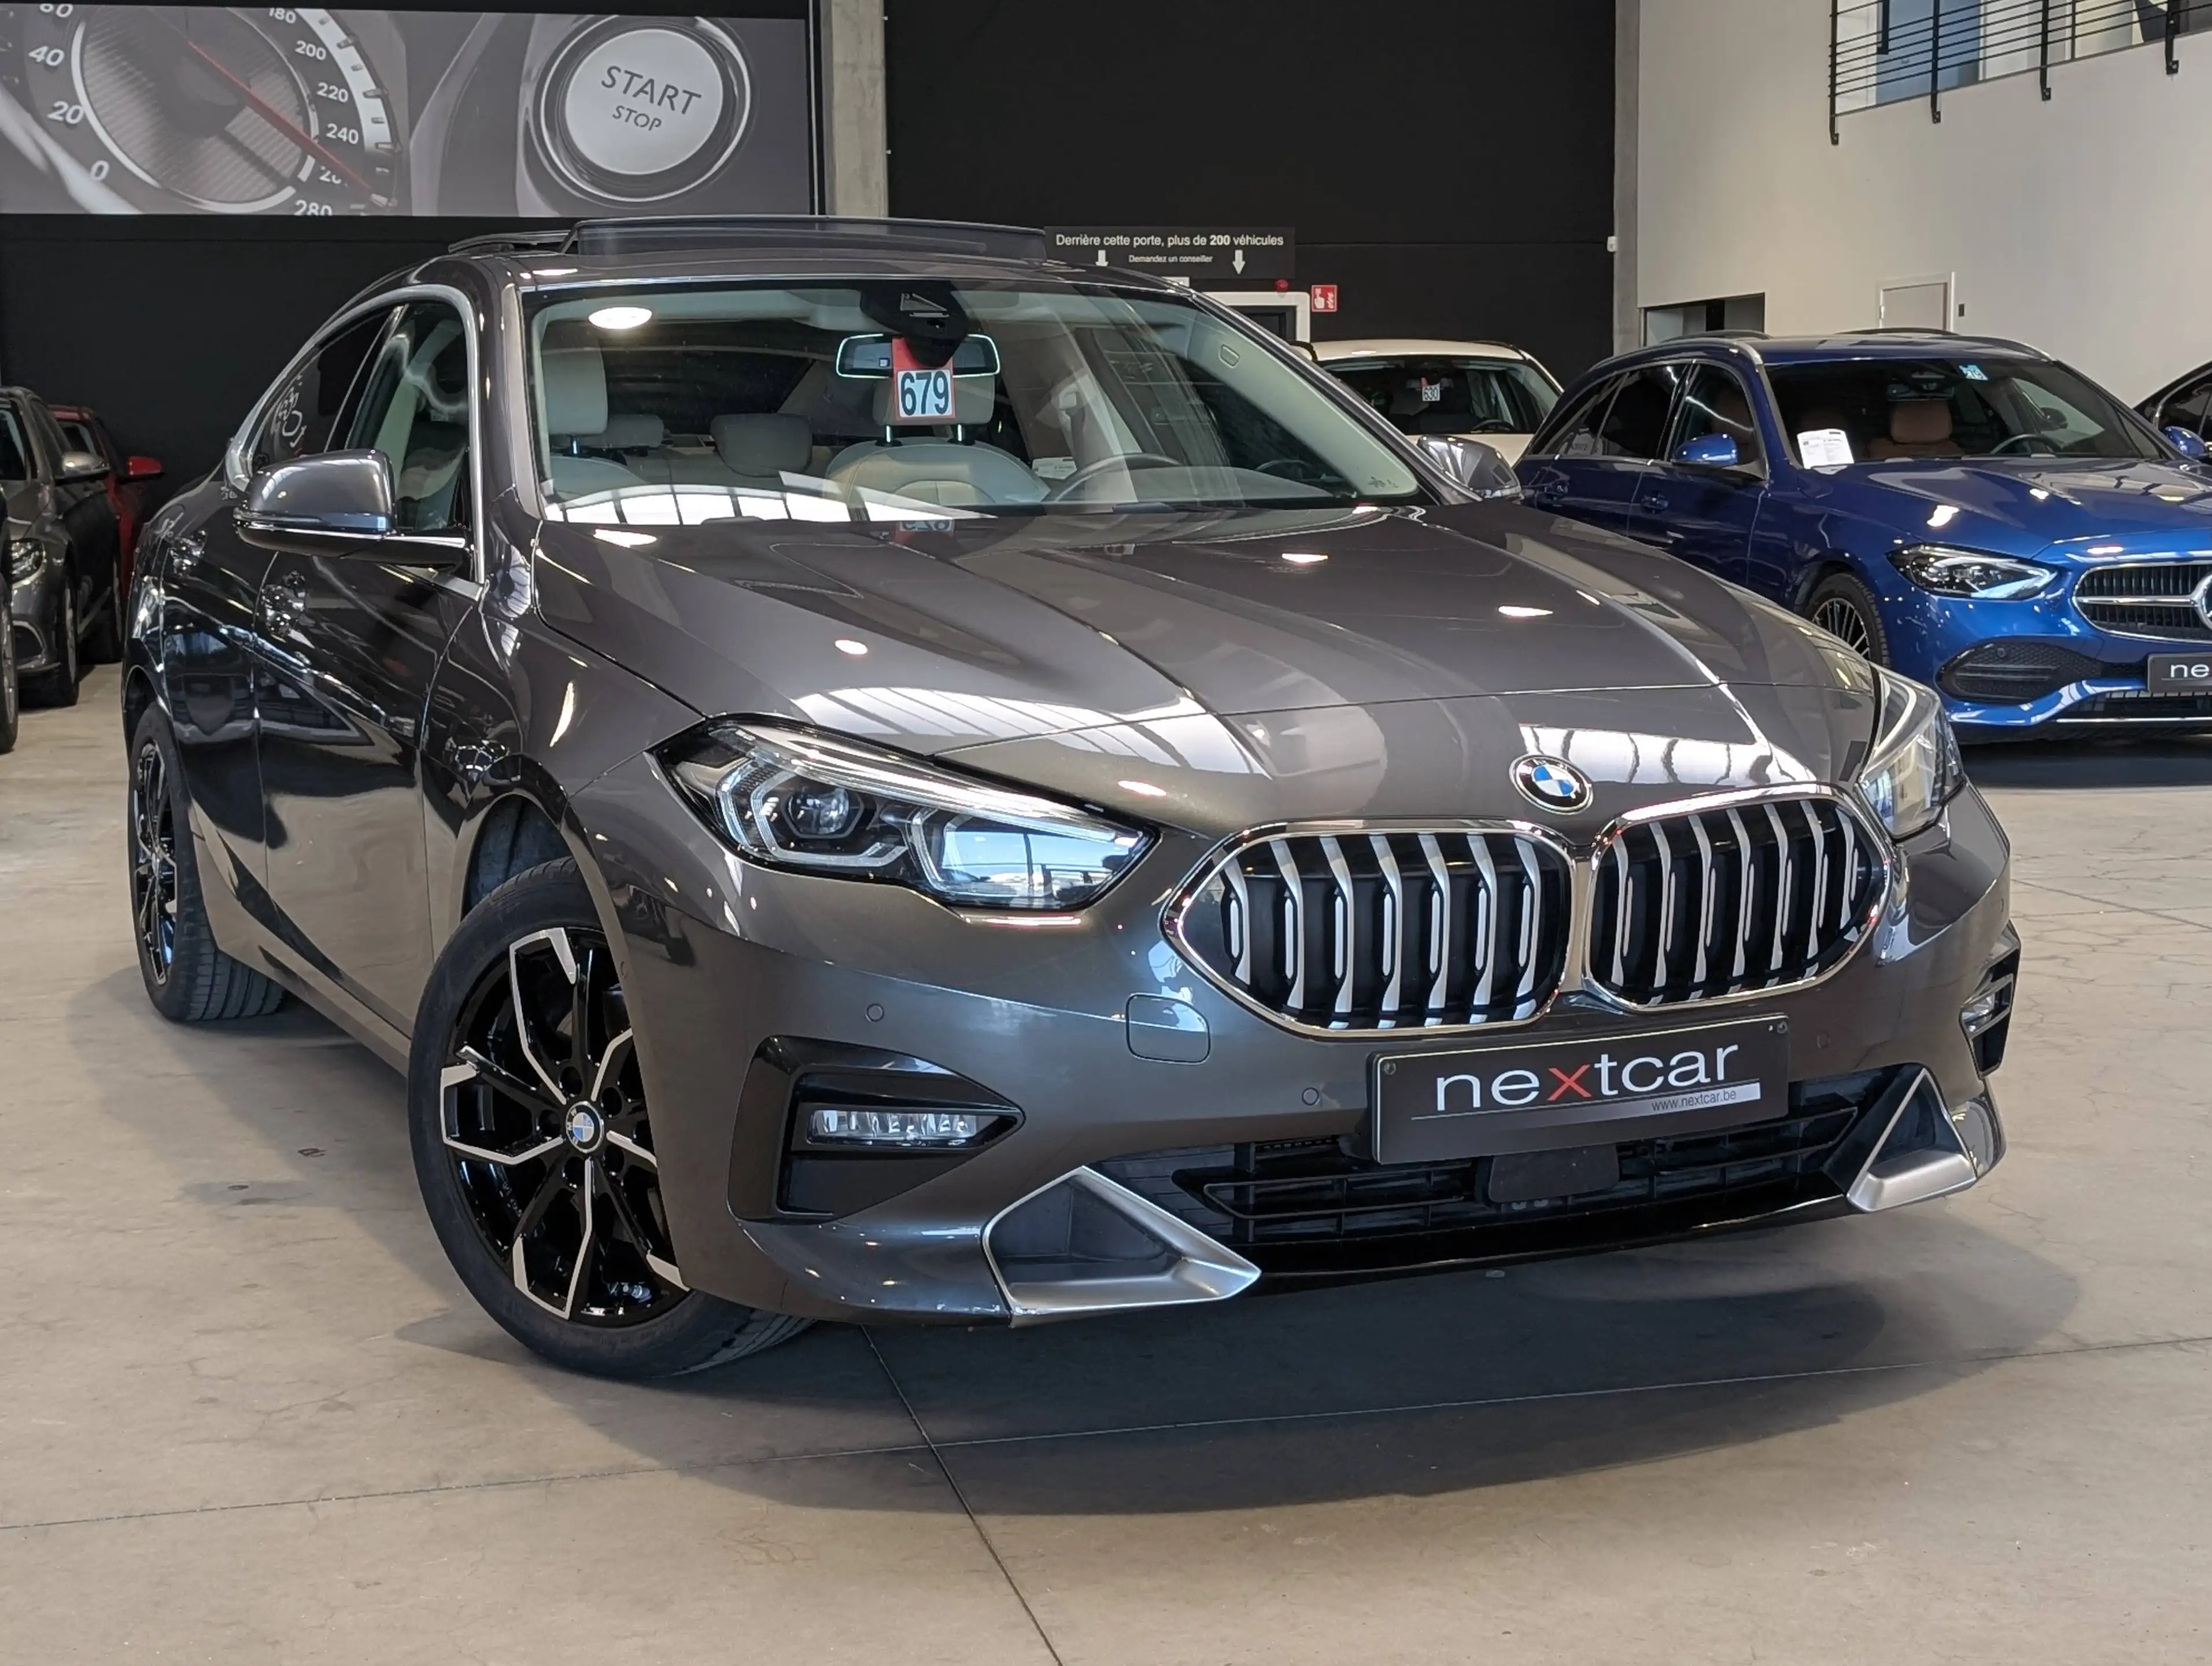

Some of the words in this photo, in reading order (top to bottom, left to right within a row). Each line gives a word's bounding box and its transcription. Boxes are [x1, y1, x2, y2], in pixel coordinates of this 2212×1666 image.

[28, 46, 65, 66] 40
[294, 40, 326, 61] 200
[317, 82, 349, 103] 220
[601, 65, 702, 115] START
[47, 101, 84, 124] 20
[612, 105, 662, 131] STOP
[326, 123, 359, 145] 240
[90, 160, 110, 182] 0
[294, 199, 333, 216] 280
[1055, 234, 1101, 246] Derrière
[1103, 234, 1130, 246] cette
[1132, 235, 1164, 248] porte,
[1167, 235, 1191, 248] plus
[1192, 235, 1207, 246] de
[1209, 235, 1231, 246] 200
[1232, 234, 1284, 246] véhicules
[1128, 255, 1167, 263] Demandez
[1179, 255, 1213, 263] conseiller
[900, 371, 950, 415] 679
[1436, 1044, 1739, 1111] nextcar
[1651, 1090, 1737, 1112] www.nextcar.be
